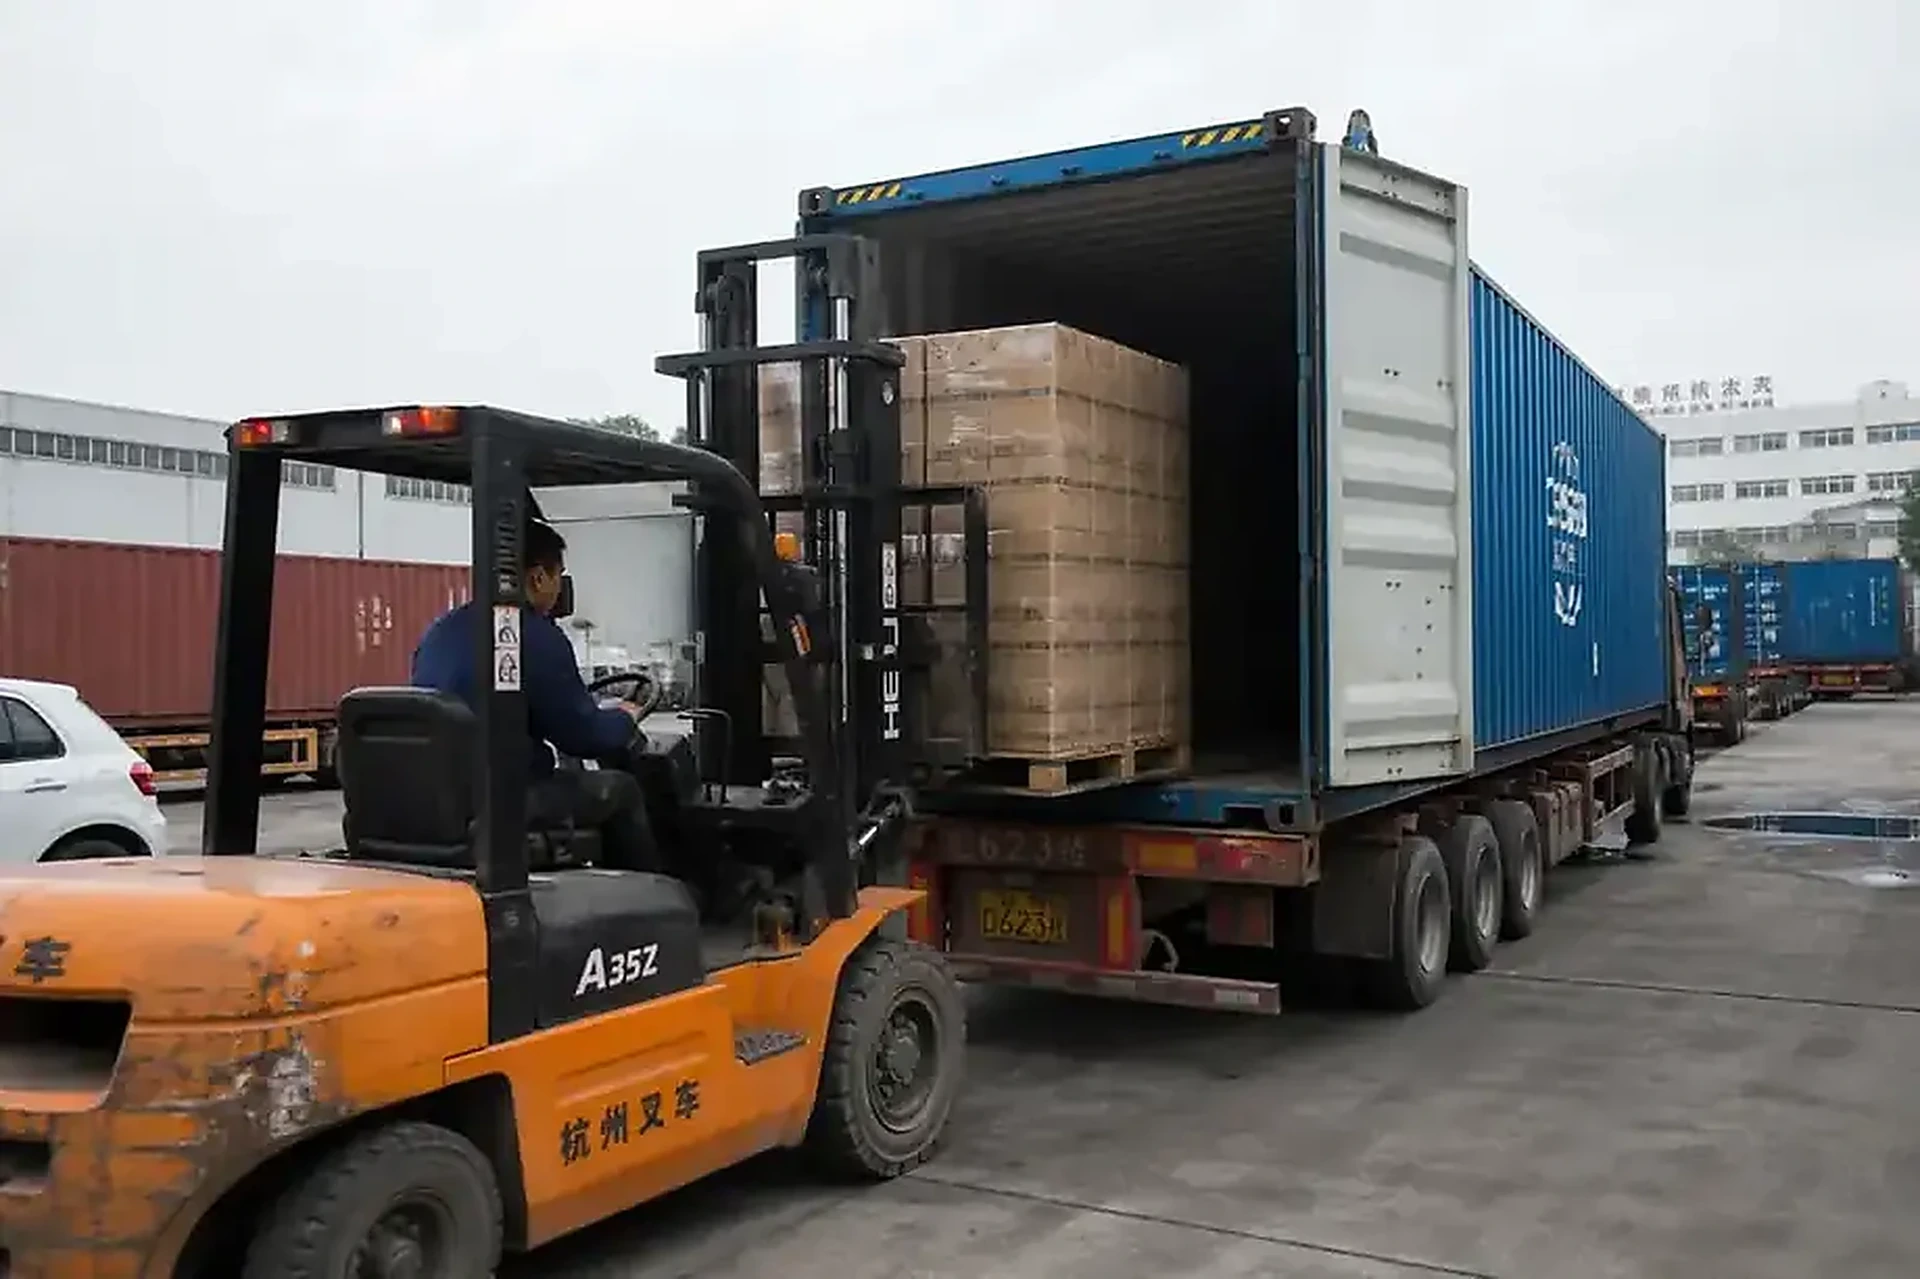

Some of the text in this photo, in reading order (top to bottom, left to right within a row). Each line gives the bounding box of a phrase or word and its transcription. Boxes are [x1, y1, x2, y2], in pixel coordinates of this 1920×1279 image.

[0, 934, 72, 984] 车
[574, 943, 660, 997] A35Z
[560, 1078, 700, 1167] 杭州叉车
